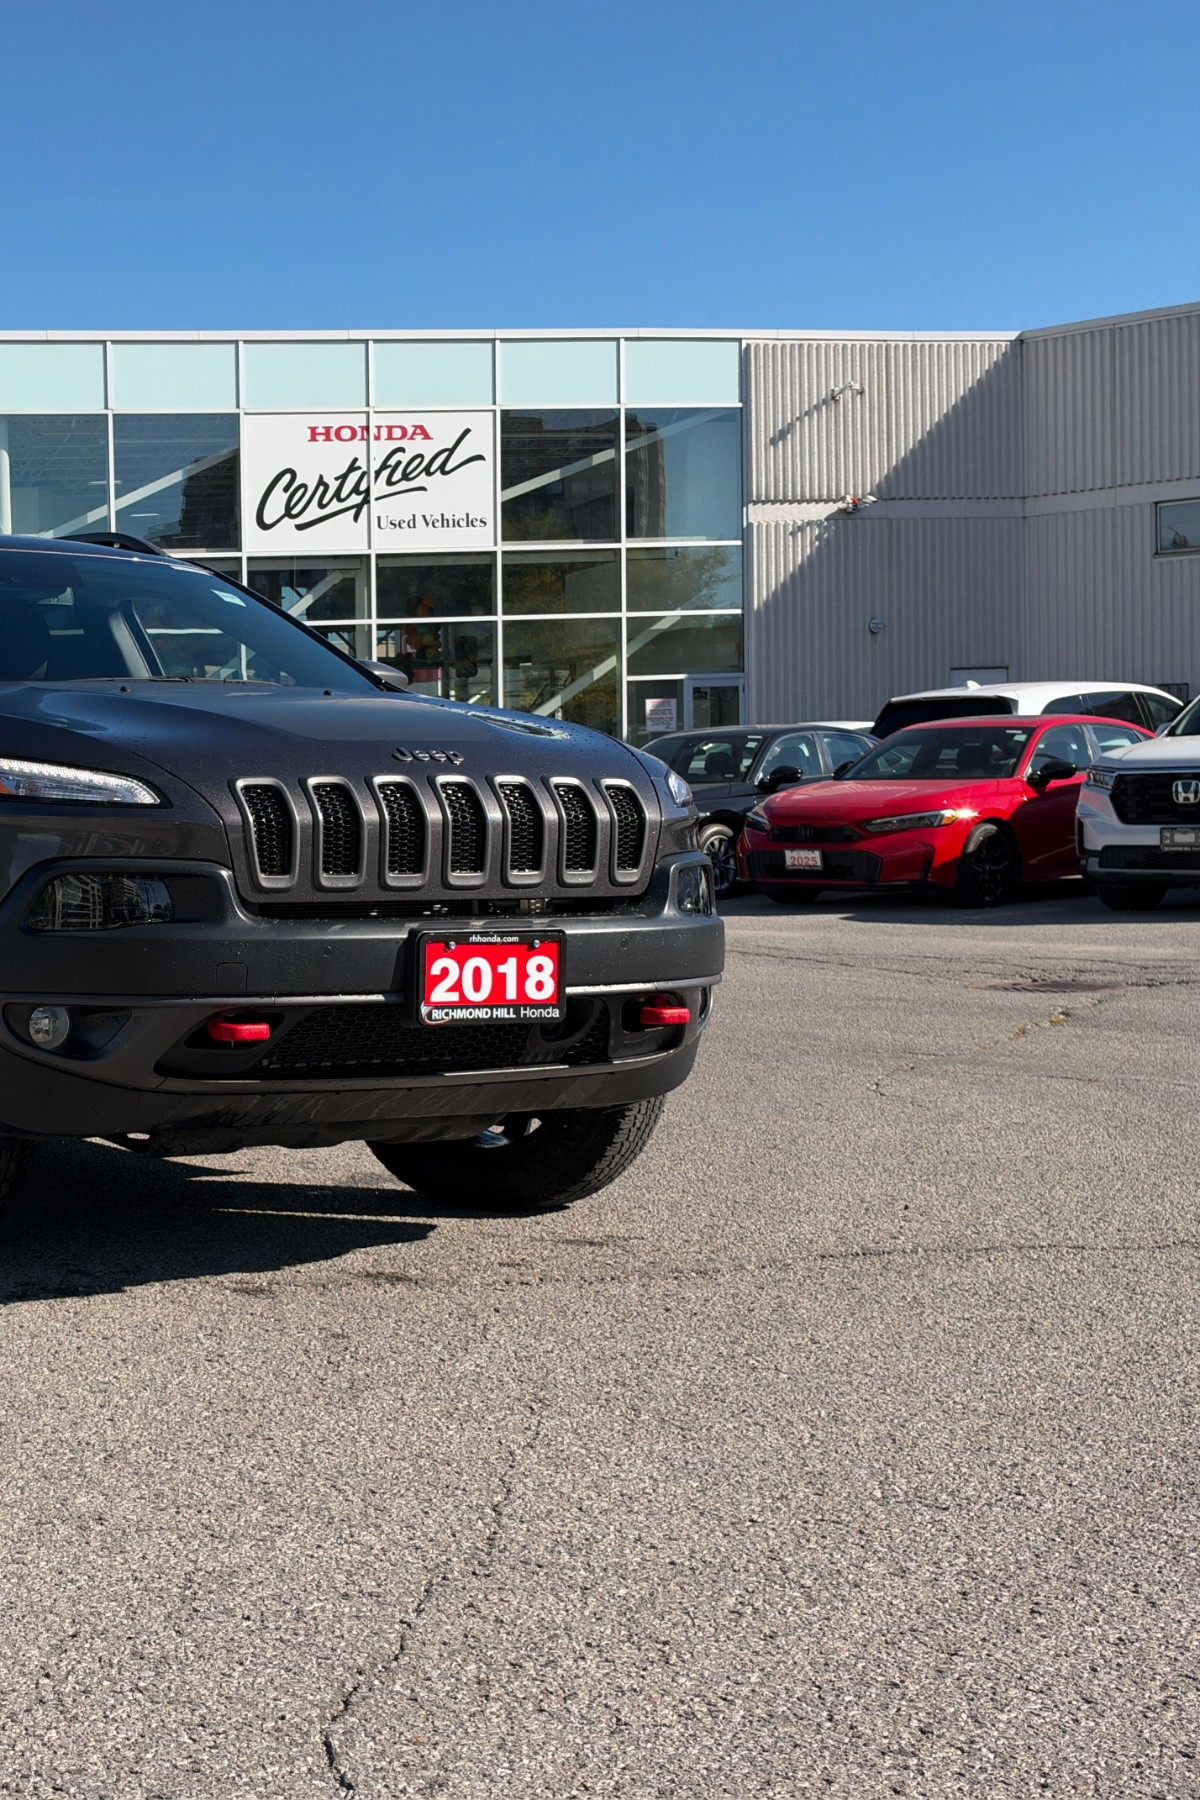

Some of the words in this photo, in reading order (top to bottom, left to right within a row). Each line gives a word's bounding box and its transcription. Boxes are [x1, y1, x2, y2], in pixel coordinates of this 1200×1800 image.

[307, 424, 434, 443] HONDA
[255, 427, 486, 531] Certified
[377, 515, 417, 530] Used
[421, 512, 488, 530] Vehicles
[391, 746, 465, 766] Jeep
[789, 856, 818, 866] 2025
[469, 935, 519, 943] rhhonda.com
[429, 955, 555, 1003] 2018
[431, 1007, 492, 1020] RICHMOND
[492, 1007, 517, 1019] HILL
[520, 1006, 560, 1019] Honda
